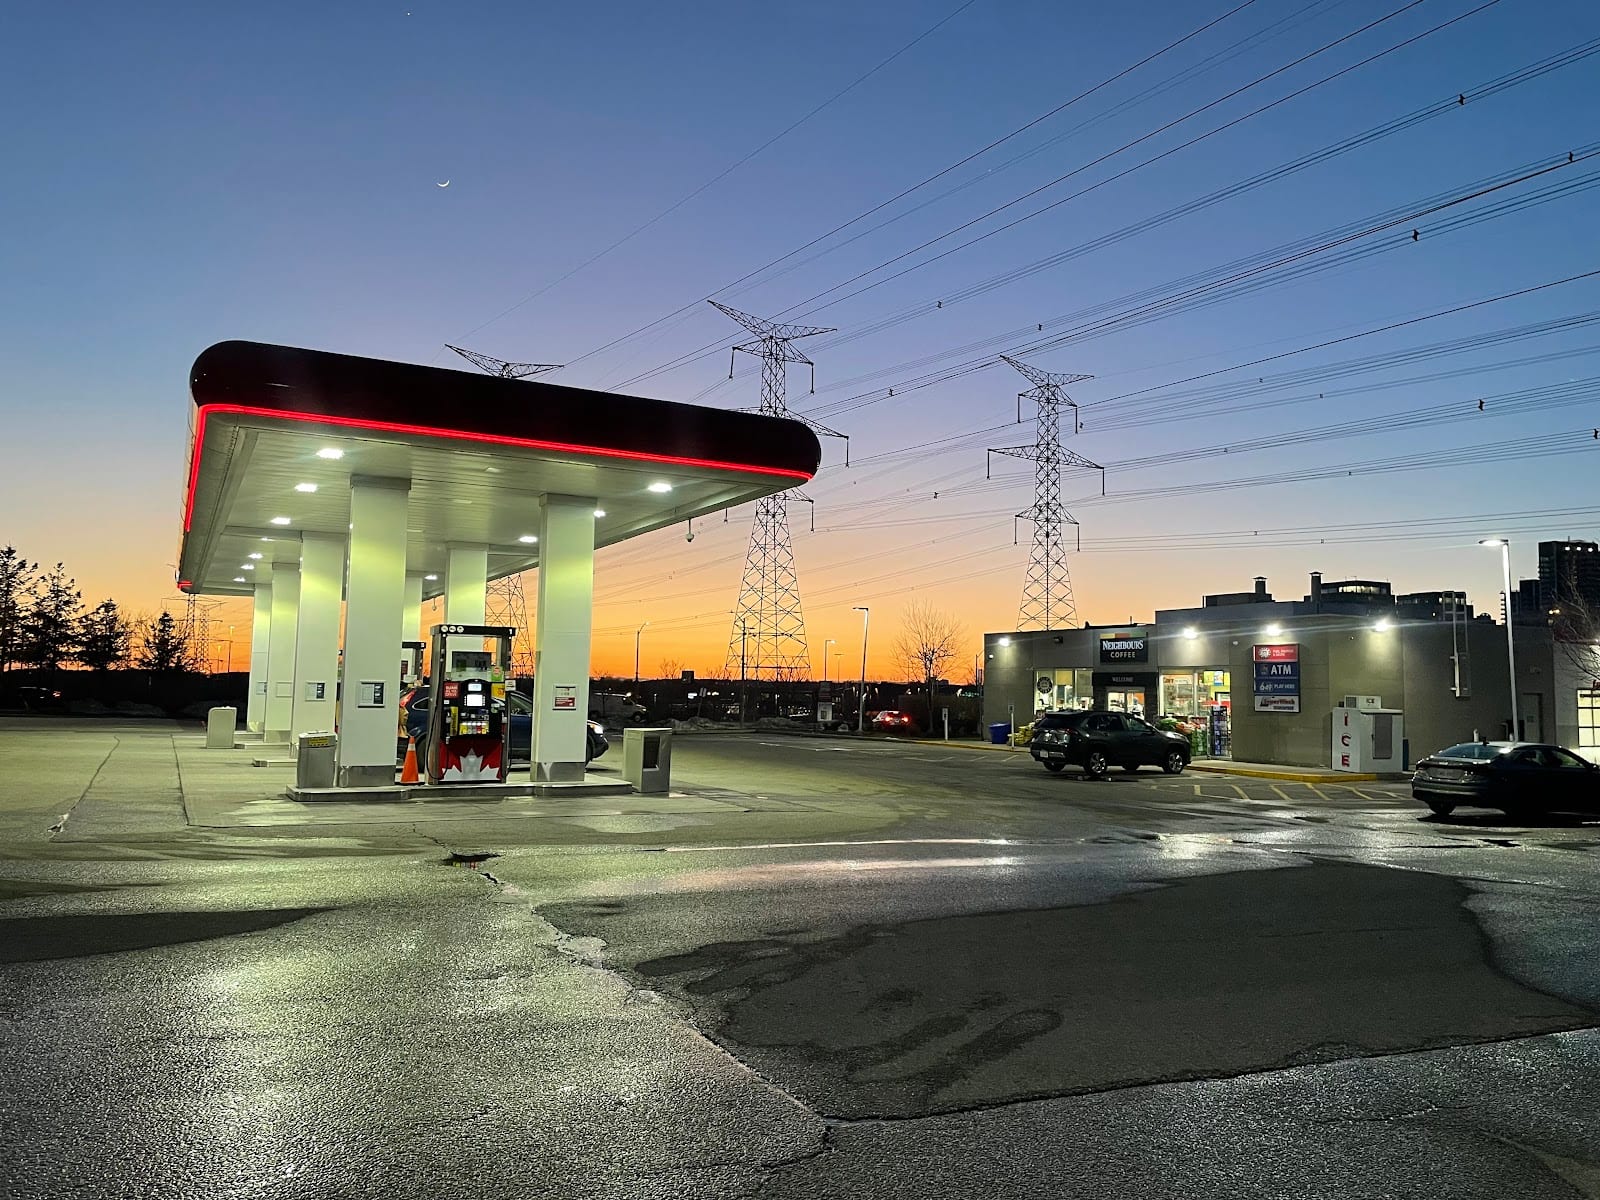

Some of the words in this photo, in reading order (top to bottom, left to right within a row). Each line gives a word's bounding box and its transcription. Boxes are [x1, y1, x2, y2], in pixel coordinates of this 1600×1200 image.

[1102, 640, 1144, 650] NEIGHBOURS
[1270, 664, 1292, 675] ATM
[1342, 712, 1351, 767] ICE
